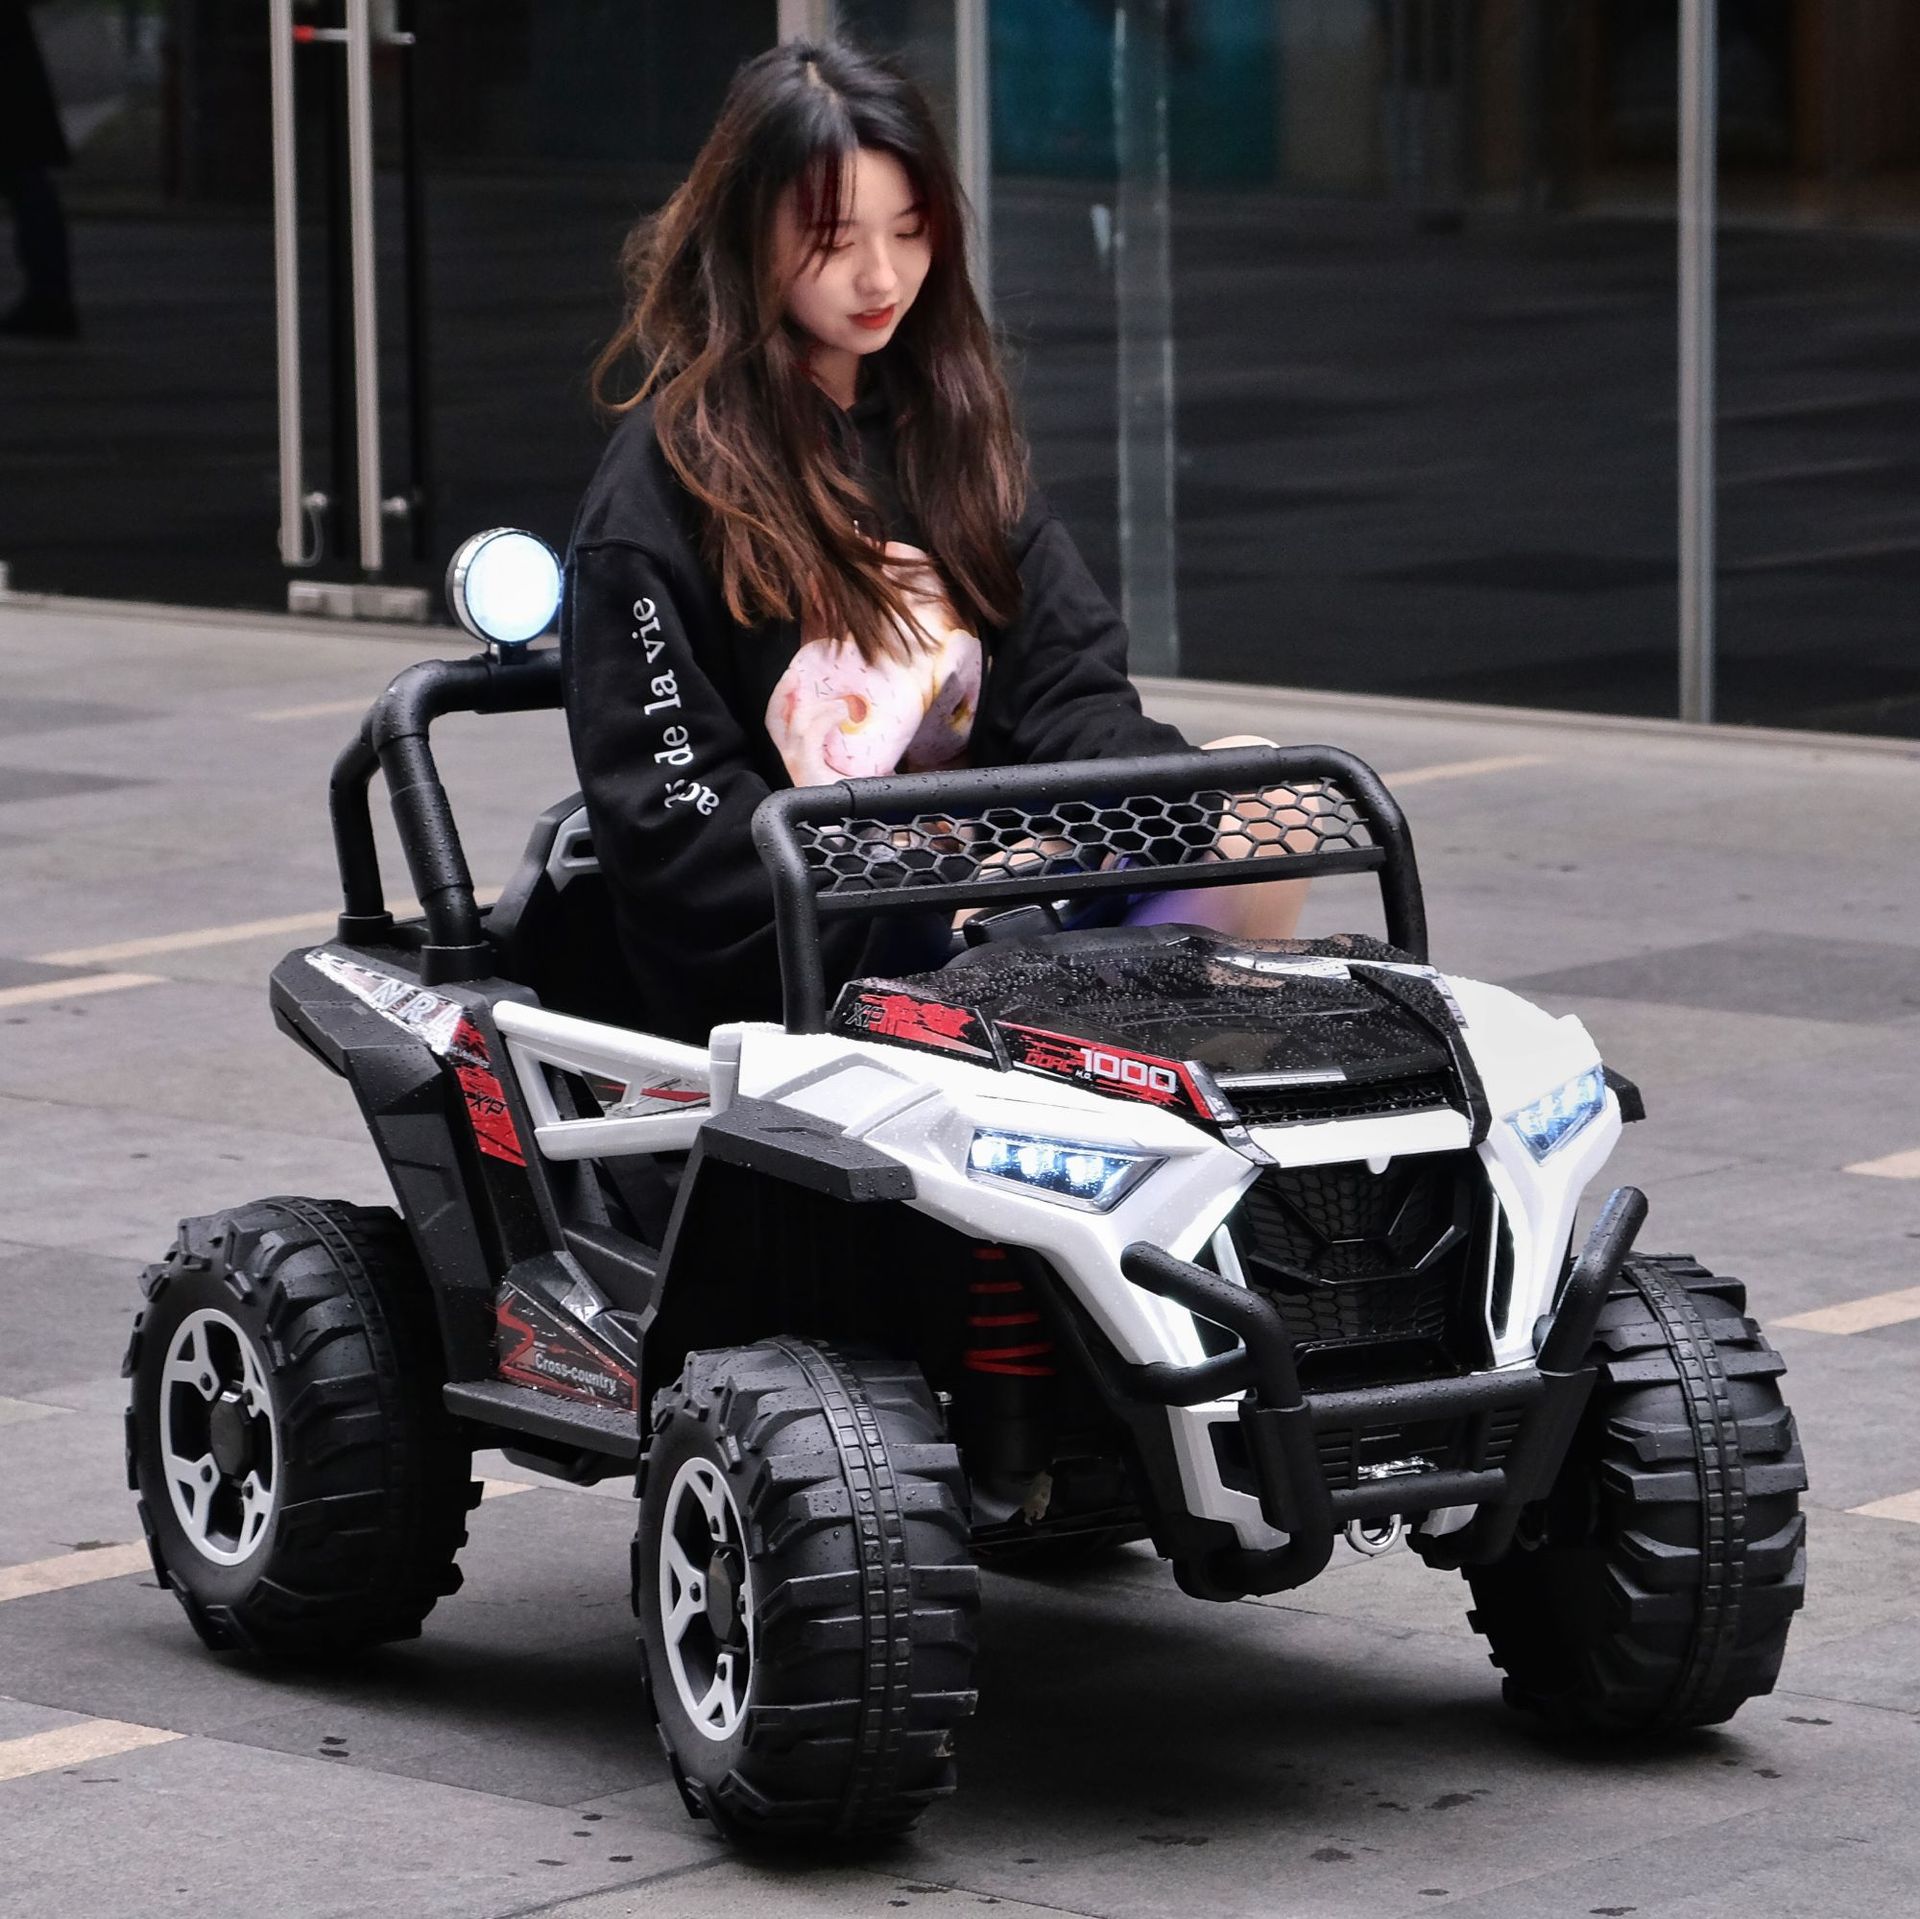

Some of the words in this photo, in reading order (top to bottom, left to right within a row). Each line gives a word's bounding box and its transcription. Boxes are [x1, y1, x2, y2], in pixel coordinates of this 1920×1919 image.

[631, 597, 666, 664] vie
[644, 668, 682, 715] la
[653, 725, 694, 766] de
[1080, 1047, 1177, 1094] 1000
[534, 1350, 617, 1396] Cross-country
